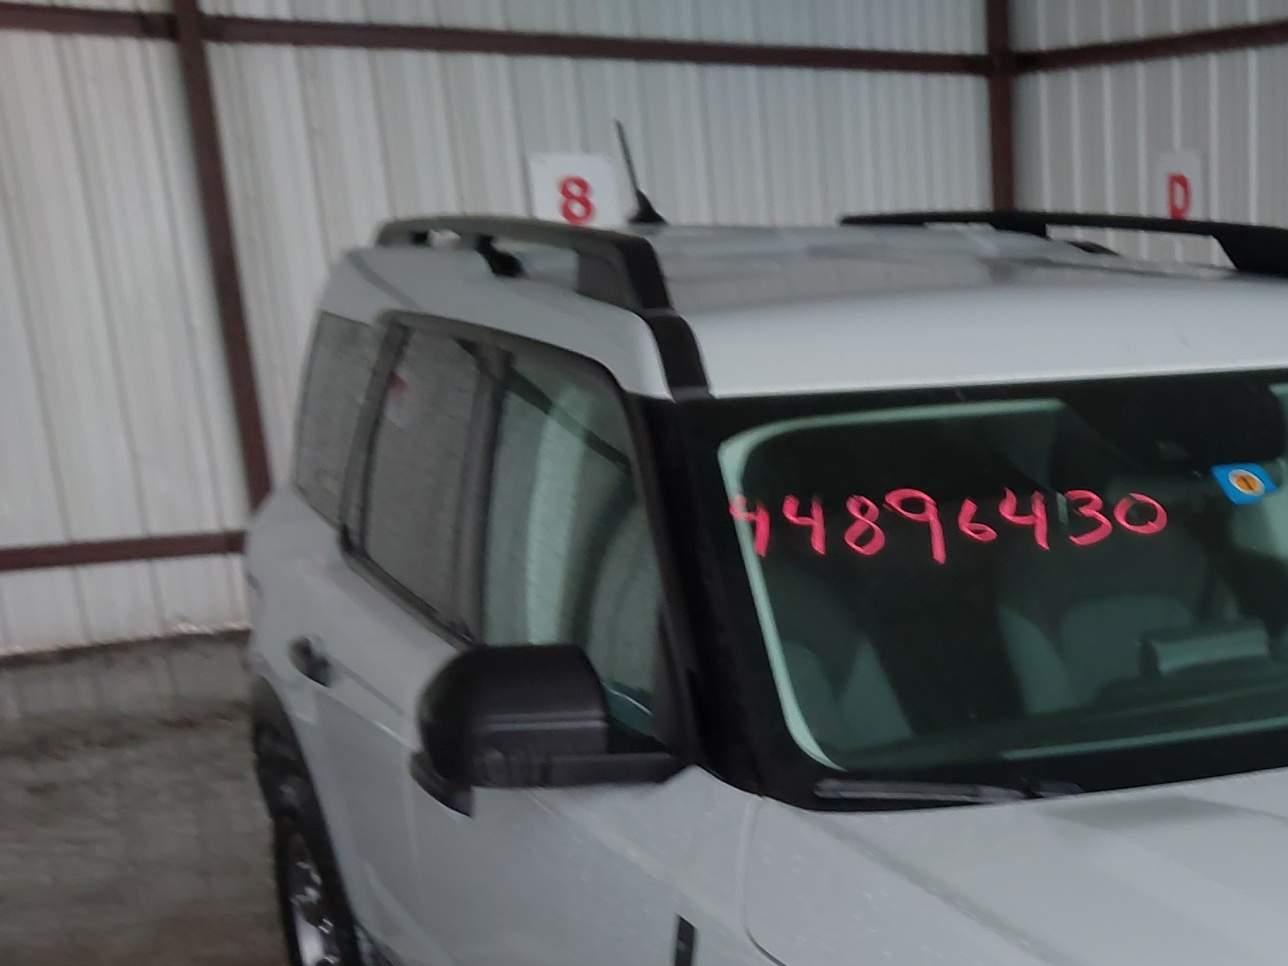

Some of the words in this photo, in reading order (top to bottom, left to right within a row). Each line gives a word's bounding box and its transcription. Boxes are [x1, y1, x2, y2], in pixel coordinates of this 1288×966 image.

[560, 175, 593, 225] 8
[1167, 172, 1191, 220] D
[729, 487, 1168, 565] 44896430
